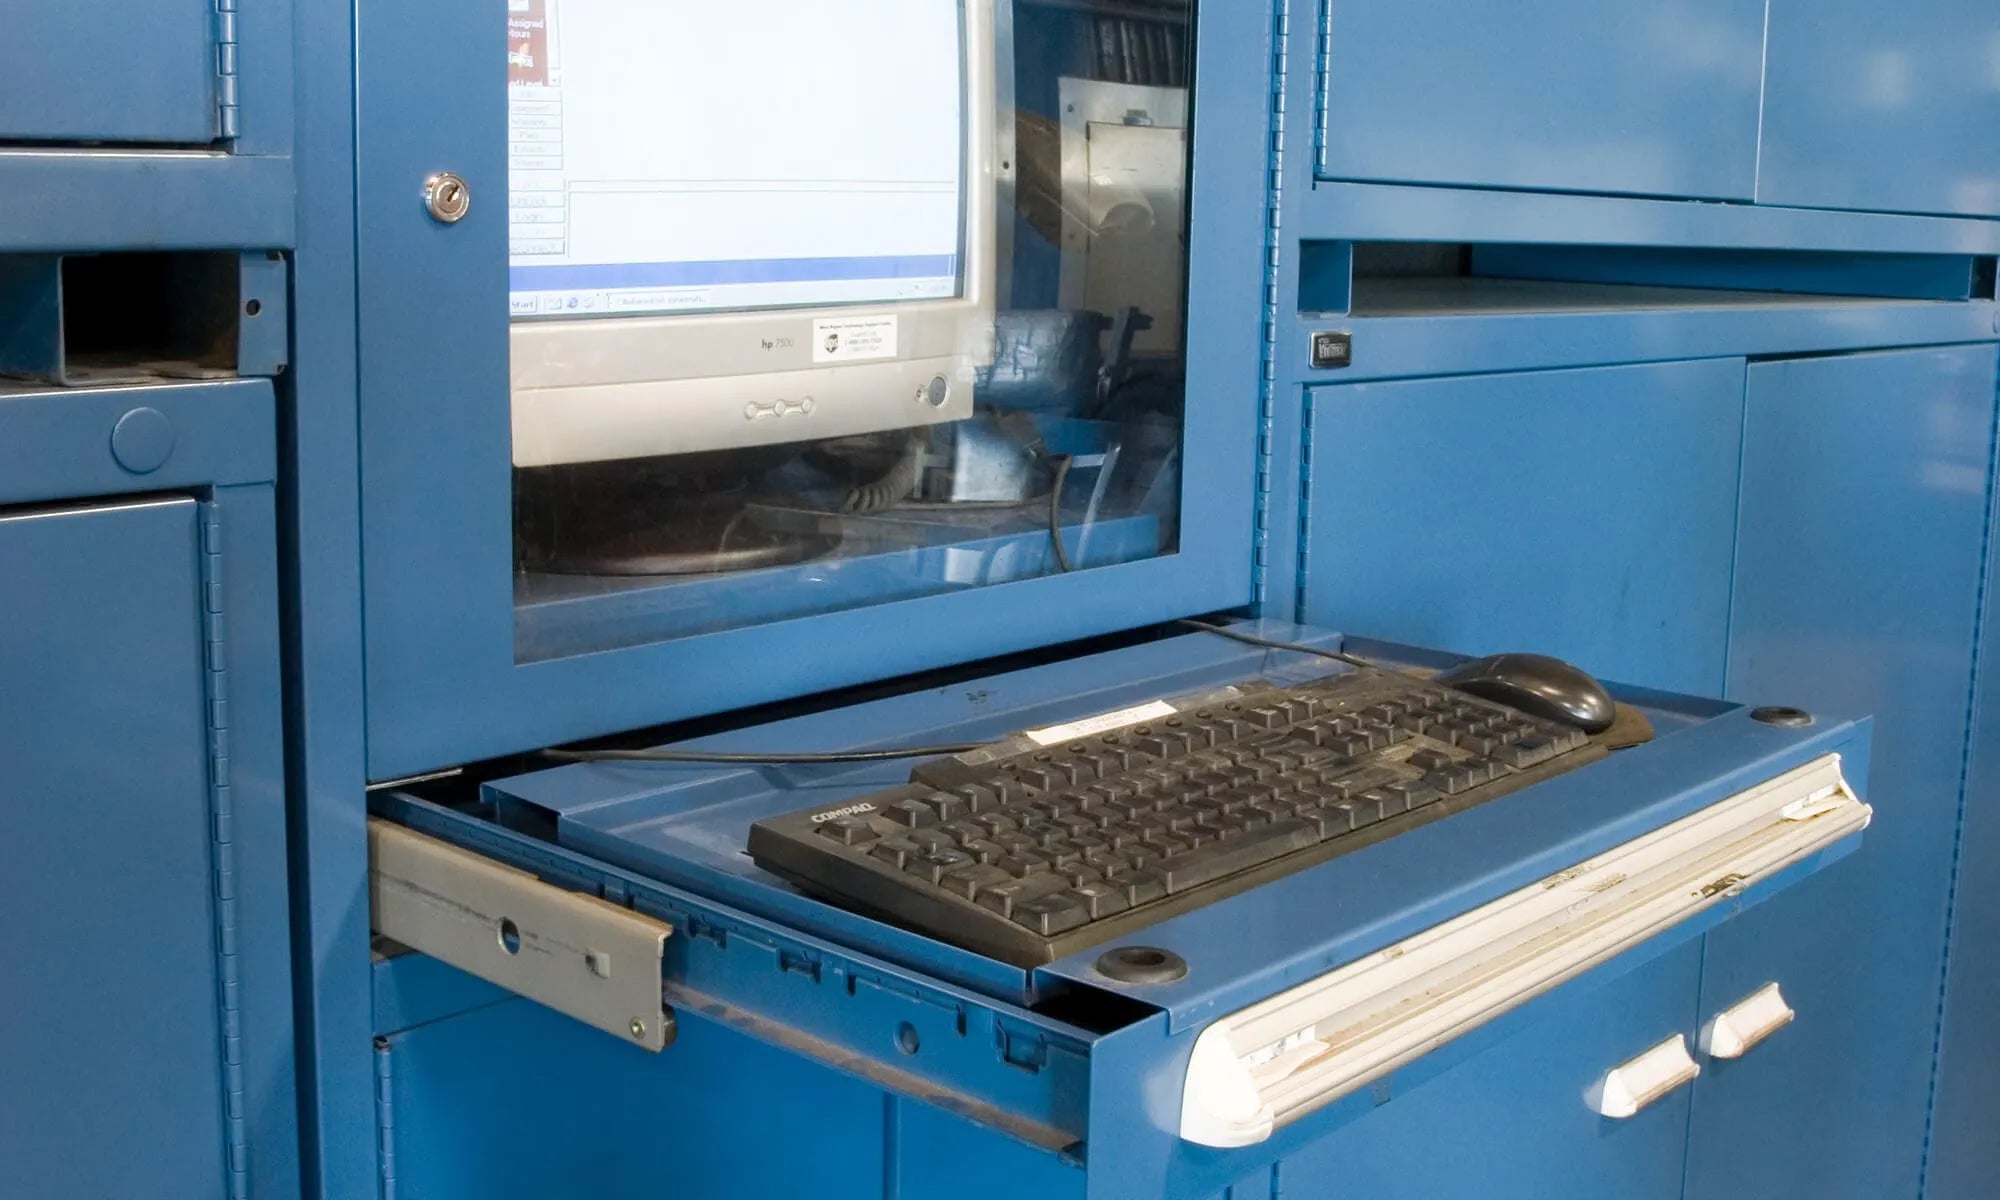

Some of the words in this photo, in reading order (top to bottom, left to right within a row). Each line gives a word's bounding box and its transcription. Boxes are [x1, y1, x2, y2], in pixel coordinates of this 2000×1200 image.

[508, 17, 544, 30] Assigned
[761, 338, 773, 351] hp
[811, 803, 877, 823] COMPAQ
